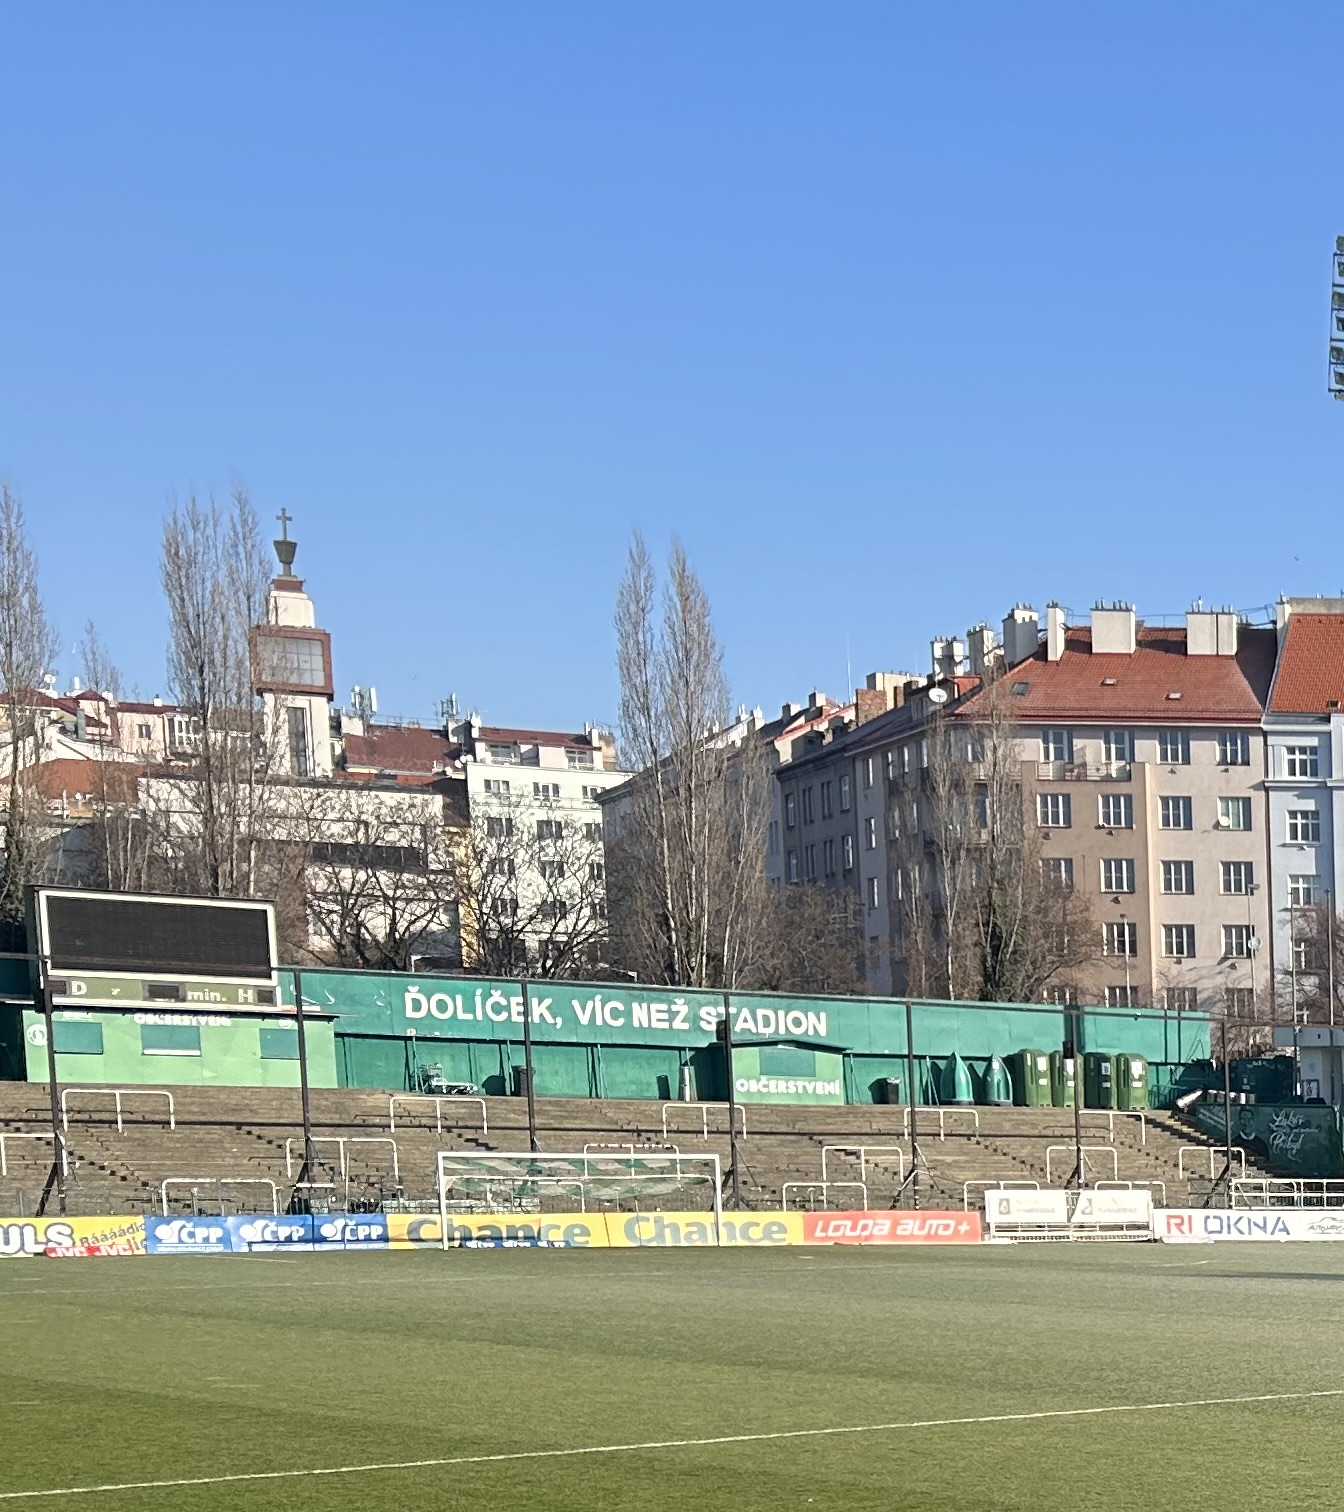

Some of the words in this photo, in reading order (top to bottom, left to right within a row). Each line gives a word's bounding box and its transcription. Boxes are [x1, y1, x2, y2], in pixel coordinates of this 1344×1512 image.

[404, 985, 562, 1029] ĎOLÍČEK,
[572, 994, 625, 1026] VÍC
[631, 998, 690, 1030] NEŽ
[699, 1006, 827, 1037] STADION
[735, 1078, 841, 1095] OBČERSTVENÍ
[180, 1221, 224, 1243] ČPP
[264, 1220, 305, 1241] ČPP
[345, 1219, 384, 1241] ČPP
[406, 1217, 592, 1247] Chance
[623, 1215, 788, 1245] Chance
[1166, 1215, 1193, 1234] RI
[1203, 1216, 1291, 1235] OKNA
